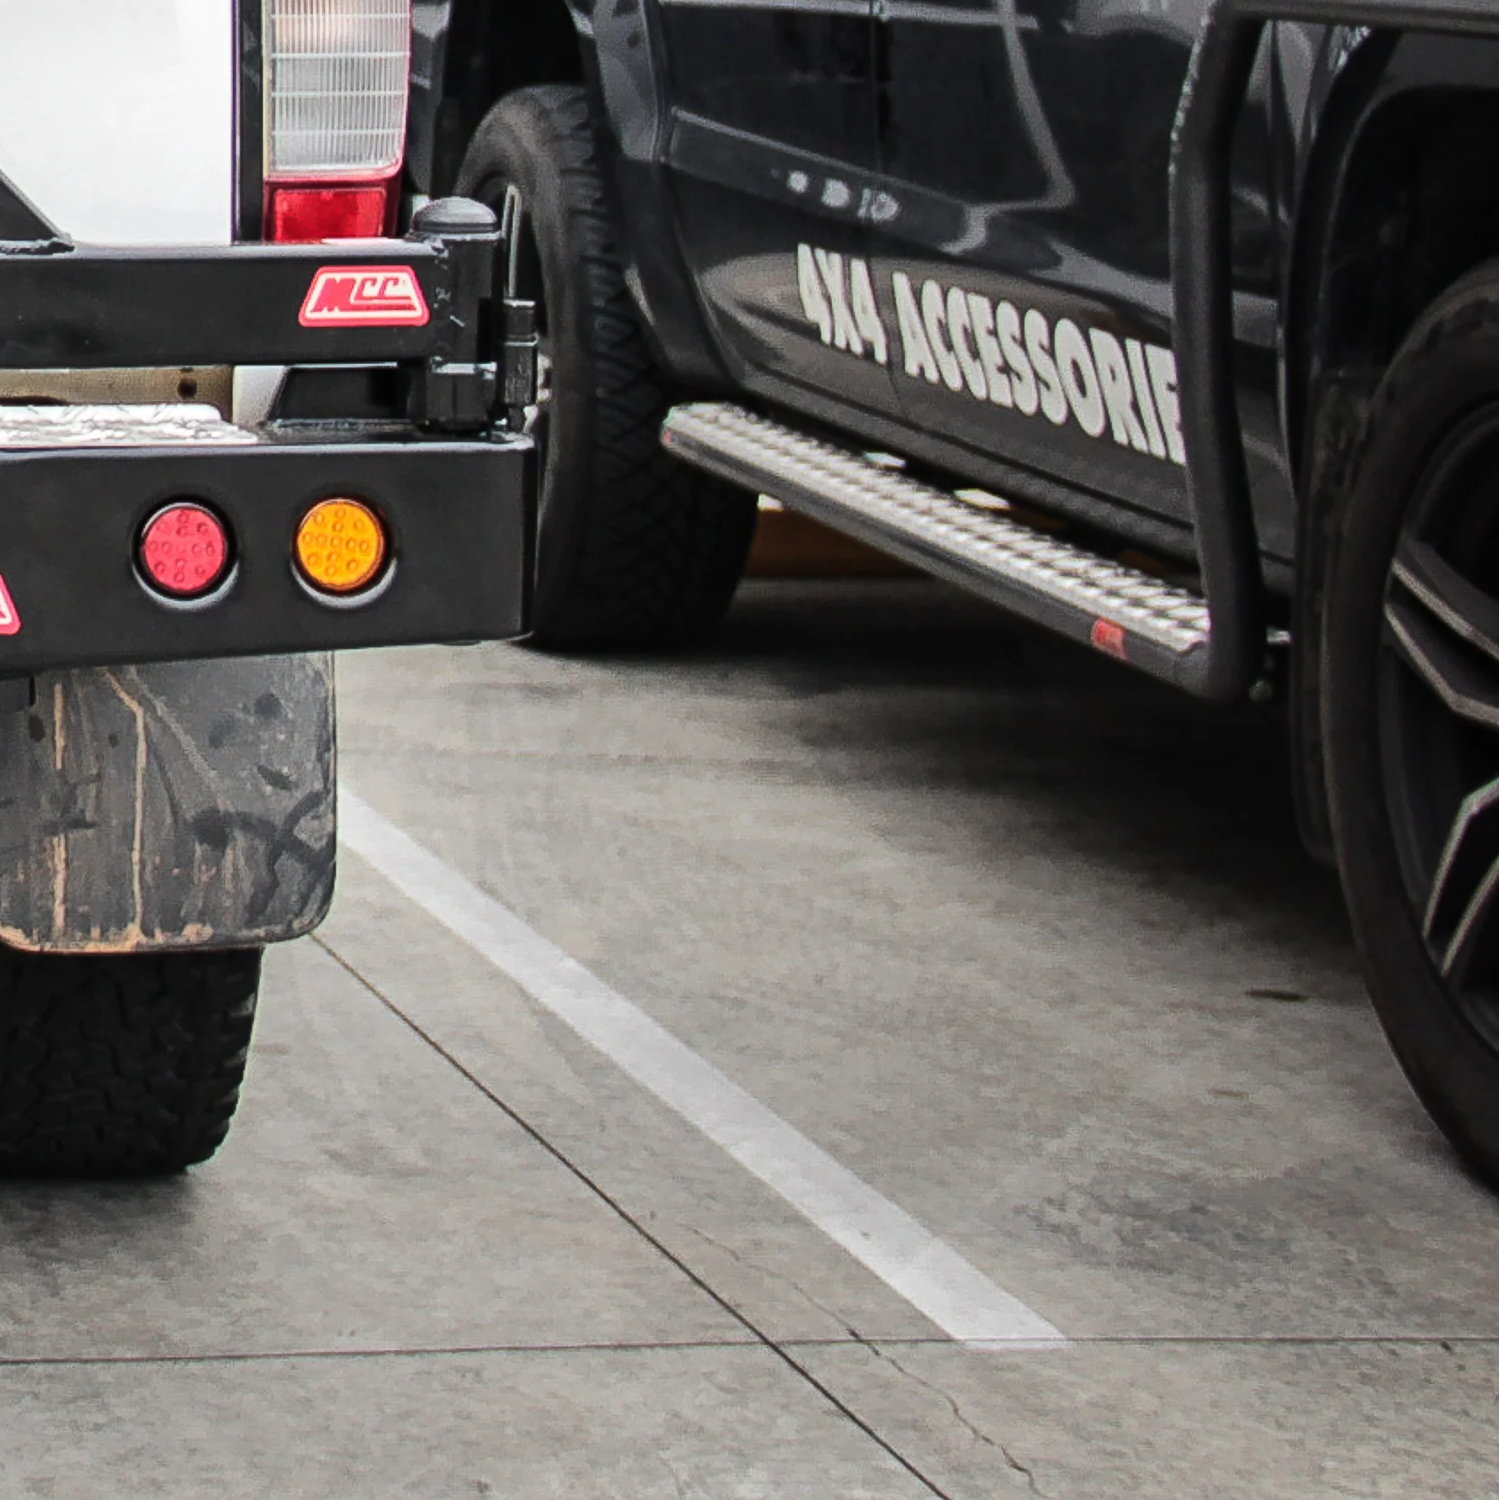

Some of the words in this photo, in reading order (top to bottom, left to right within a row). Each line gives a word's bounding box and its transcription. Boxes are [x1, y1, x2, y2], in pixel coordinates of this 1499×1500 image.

[309, 277, 413, 312] MCC
[797, 242, 888, 365] 4X4
[892, 271, 1188, 467] ACCESSORIE
